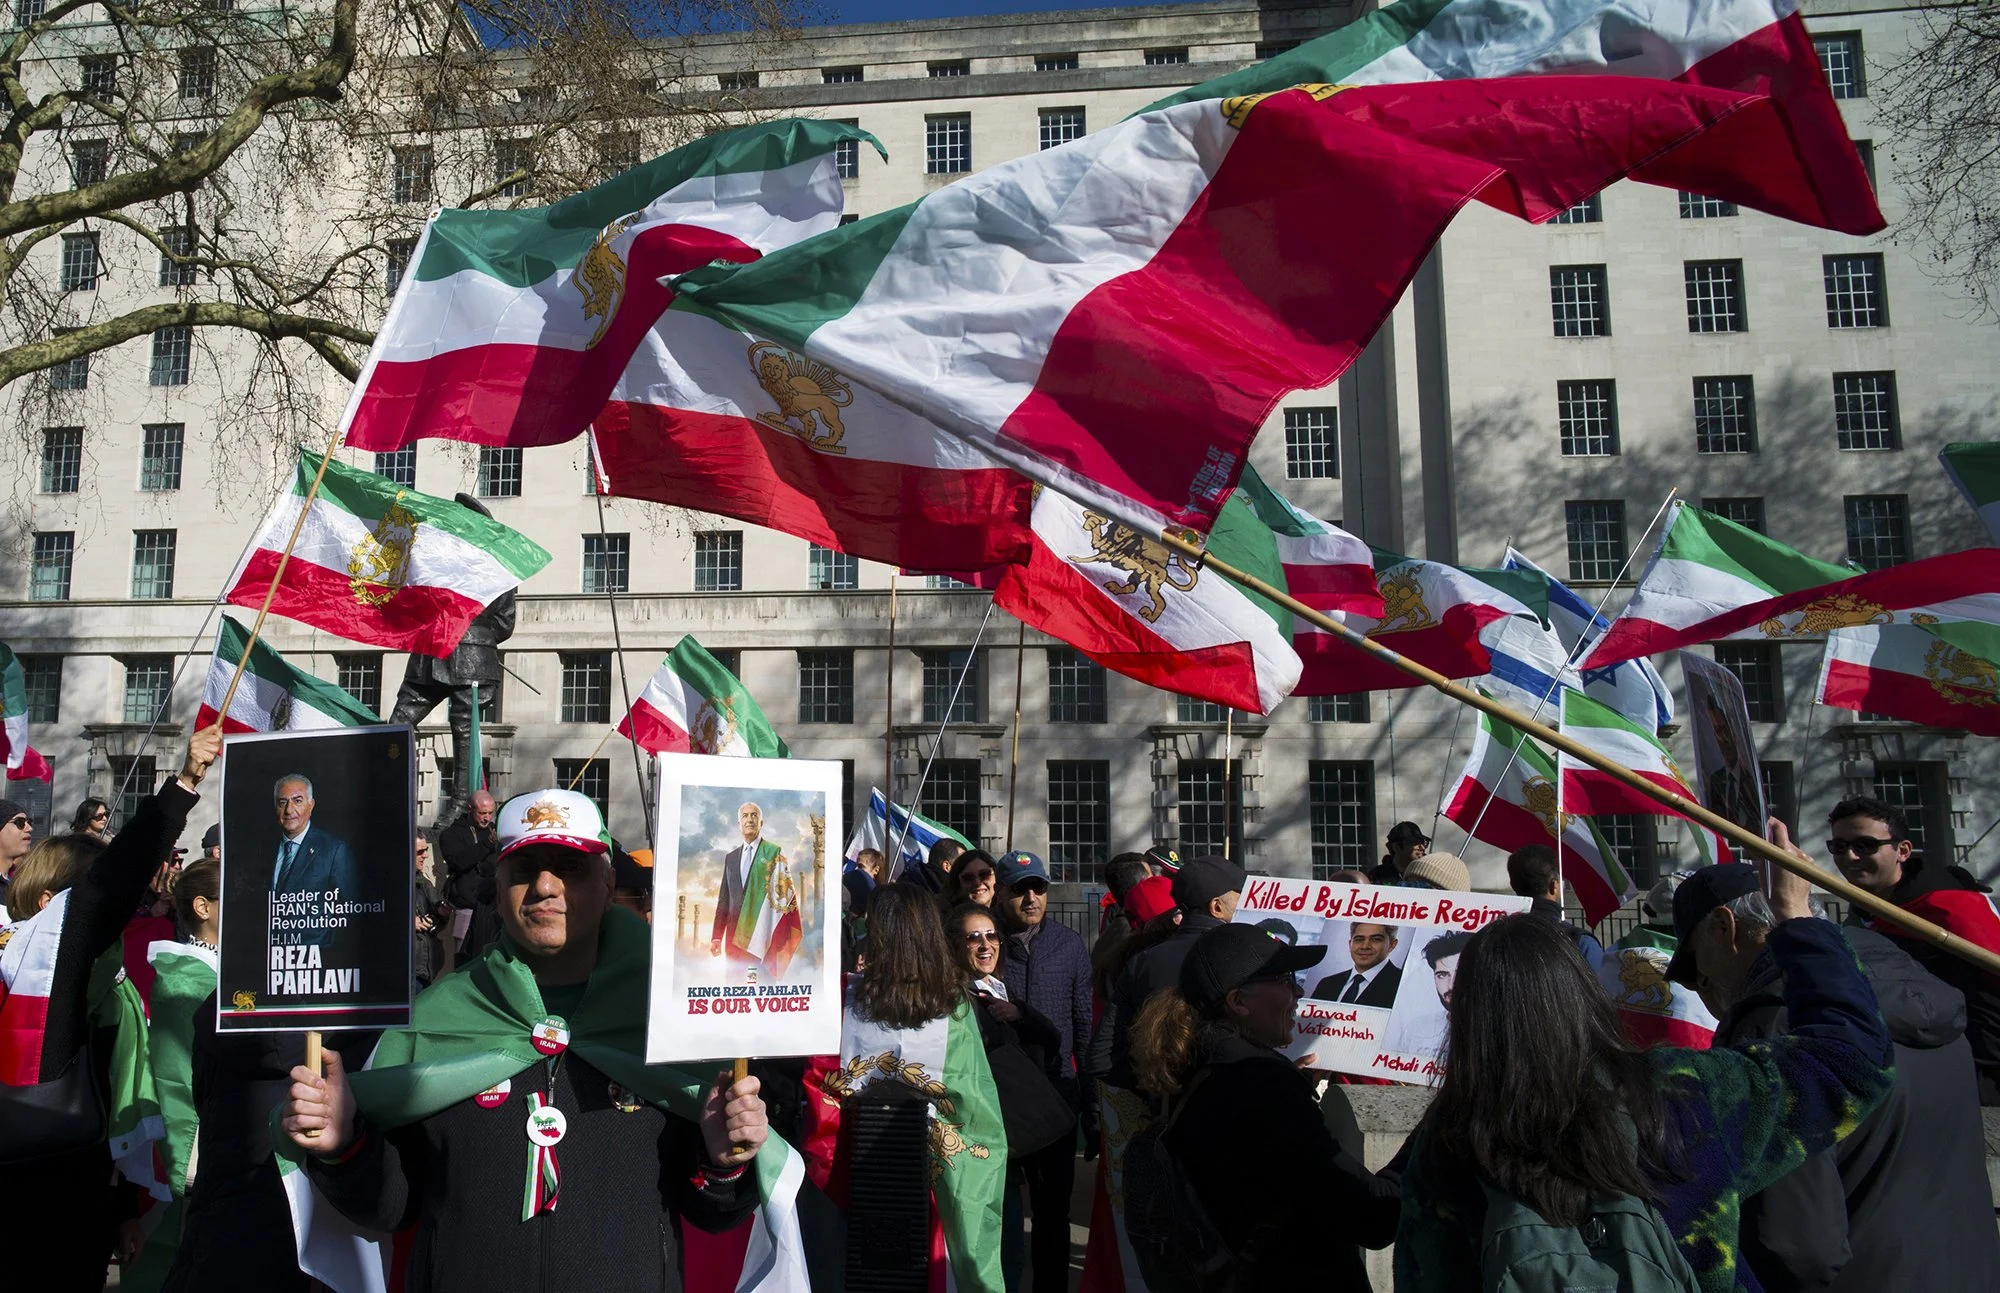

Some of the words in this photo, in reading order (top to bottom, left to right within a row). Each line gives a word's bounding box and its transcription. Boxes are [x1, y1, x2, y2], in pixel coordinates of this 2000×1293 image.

[1189, 460, 1217, 494] STAGE
[1207, 445, 1222, 461] OF
[1202, 451, 1236, 501] FREEDOM
[272, 889, 320, 903] Leader
[324, 888, 339, 901] of
[272, 903, 319, 916] IRAN's
[324, 899, 385, 914] National
[1243, 880, 1310, 911] Killed
[1314, 885, 1343, 918] By
[1341, 888, 1429, 920] Islamic
[1434, 899, 1522, 931] Regim
[272, 915, 347, 930] Revolution
[271, 933, 301, 945] H.I.M
[271, 944, 322, 970] REZA
[271, 968, 360, 995] PAHLAVI
[687, 987, 721, 998] KING
[723, 986, 757, 997] REZA
[759, 985, 812, 996] PAHLAVI
[688, 998, 708, 1014] IS
[711, 998, 751, 1014] OUR
[755, 996, 810, 1013] VOICE
[1301, 1004, 1357, 1022] Javad
[545, 1018, 565, 1028] FREE
[1297, 1022, 1374, 1041] Vatankhah
[540, 1040, 557, 1050] IRAN
[1372, 1054, 1419, 1072] Mehdi
[482, 1094, 500, 1102] IRAN
